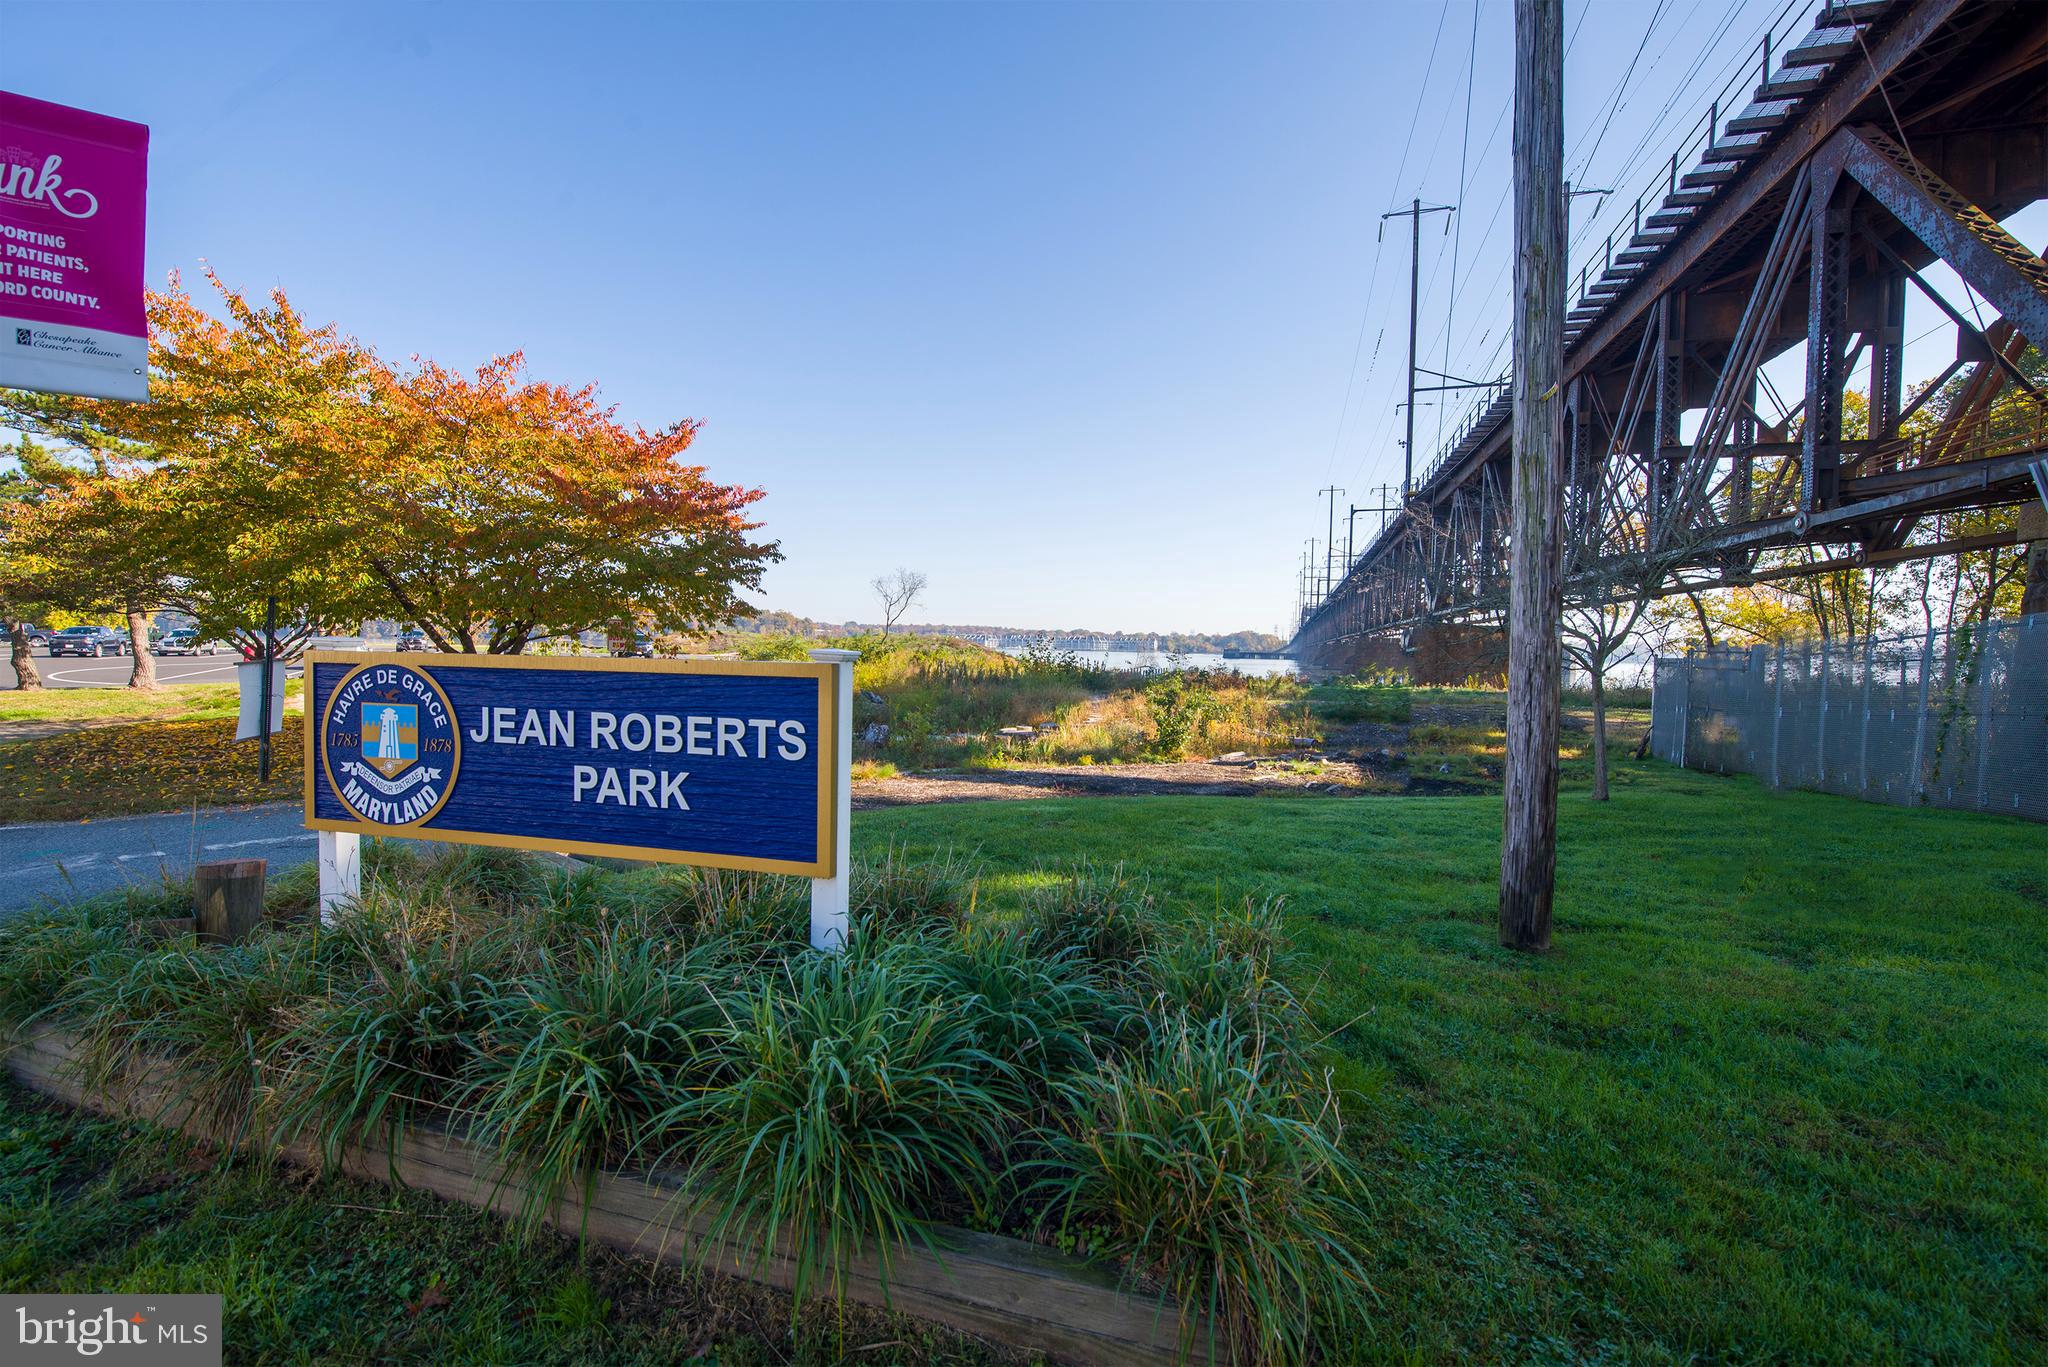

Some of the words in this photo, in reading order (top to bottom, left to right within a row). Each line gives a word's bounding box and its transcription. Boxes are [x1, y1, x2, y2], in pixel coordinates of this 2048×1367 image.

[6, 243, 90, 273] PATIENTS,
[17, 264, 64, 285] HERE
[31, 285, 101, 310] COUNTY.
[33, 330, 97, 346] Chesapeake
[33, 340, 72, 353] Cancer
[74, 346, 122, 359] Alliance
[333, 673, 374, 725] HAVRE
[376, 669, 398, 685] DE
[402, 674, 448, 729] GRACE
[331, 732, 358, 748] 1785
[424, 737, 452, 753] 1878
[469, 706, 575, 748] JEAN
[590, 711, 807, 761] ROBERTS
[359, 766, 397, 793] DEFENSOR
[395, 772, 421, 792] PATRIAE
[573, 765, 690, 811] PARK
[342, 777, 438, 824] MARYLAND
